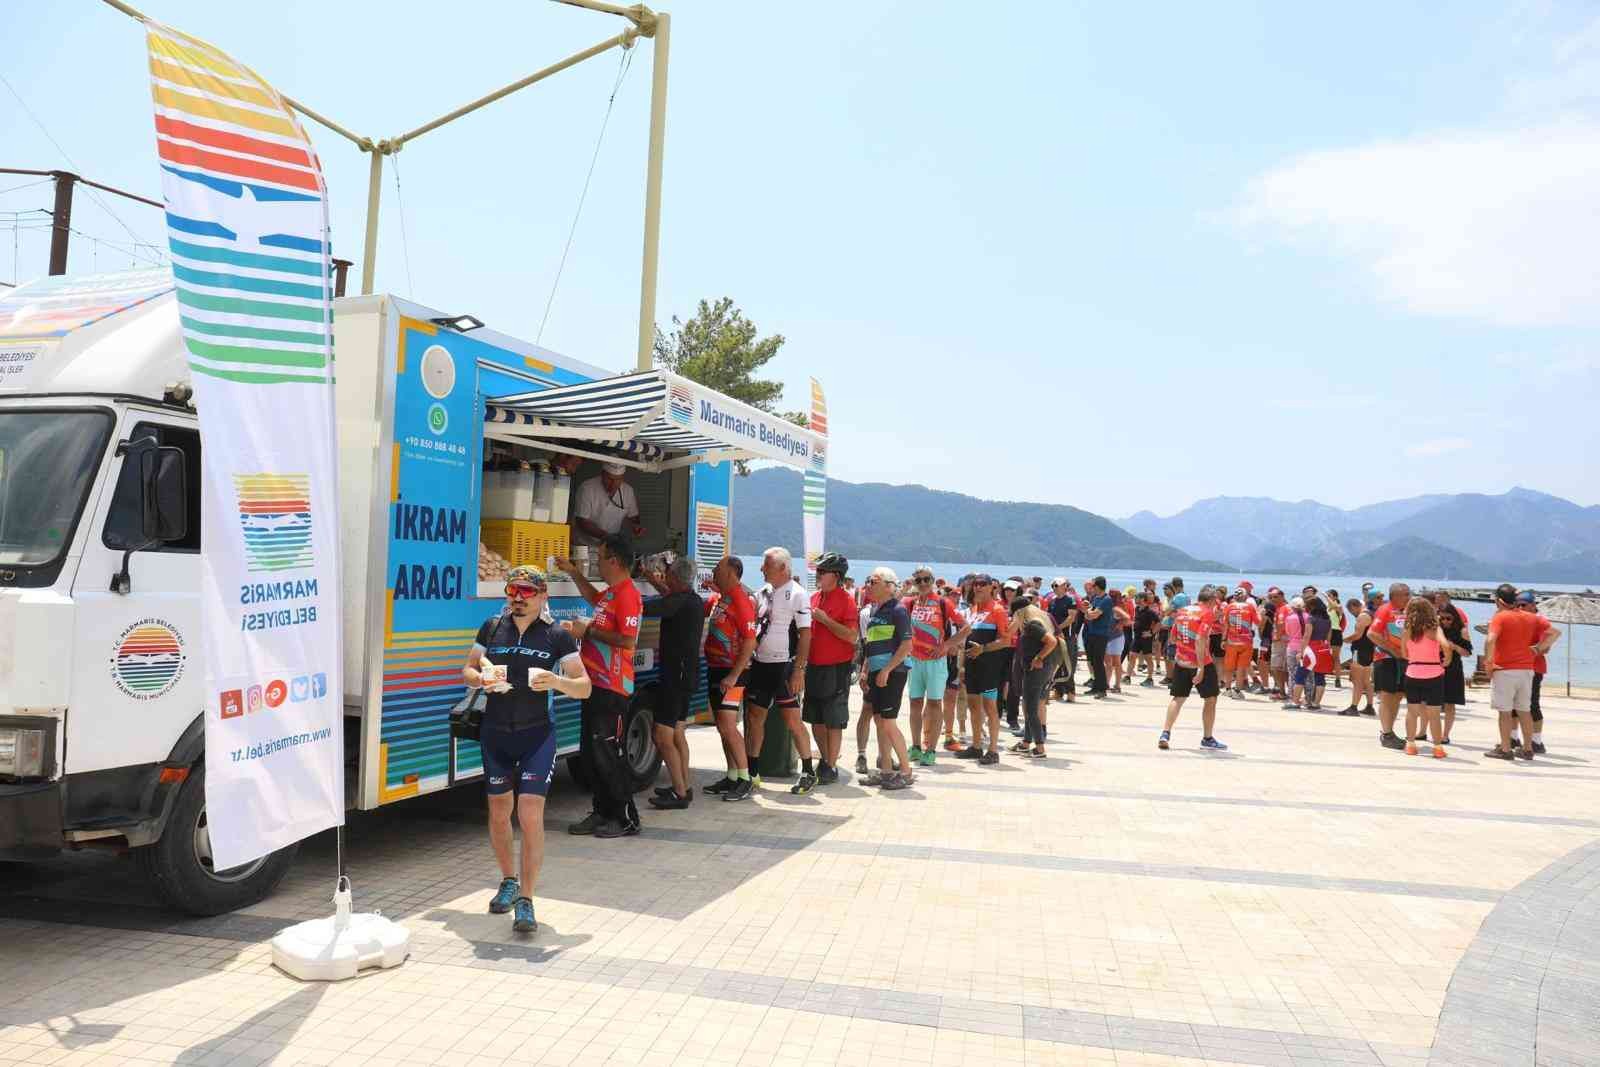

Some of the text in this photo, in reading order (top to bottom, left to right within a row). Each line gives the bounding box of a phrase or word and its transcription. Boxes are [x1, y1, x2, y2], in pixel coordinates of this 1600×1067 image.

[700, 399, 809, 457] Marmaris Belediyesi
[395, 492, 467, 545] İKRAM
[393, 563, 463, 601] ARACI
